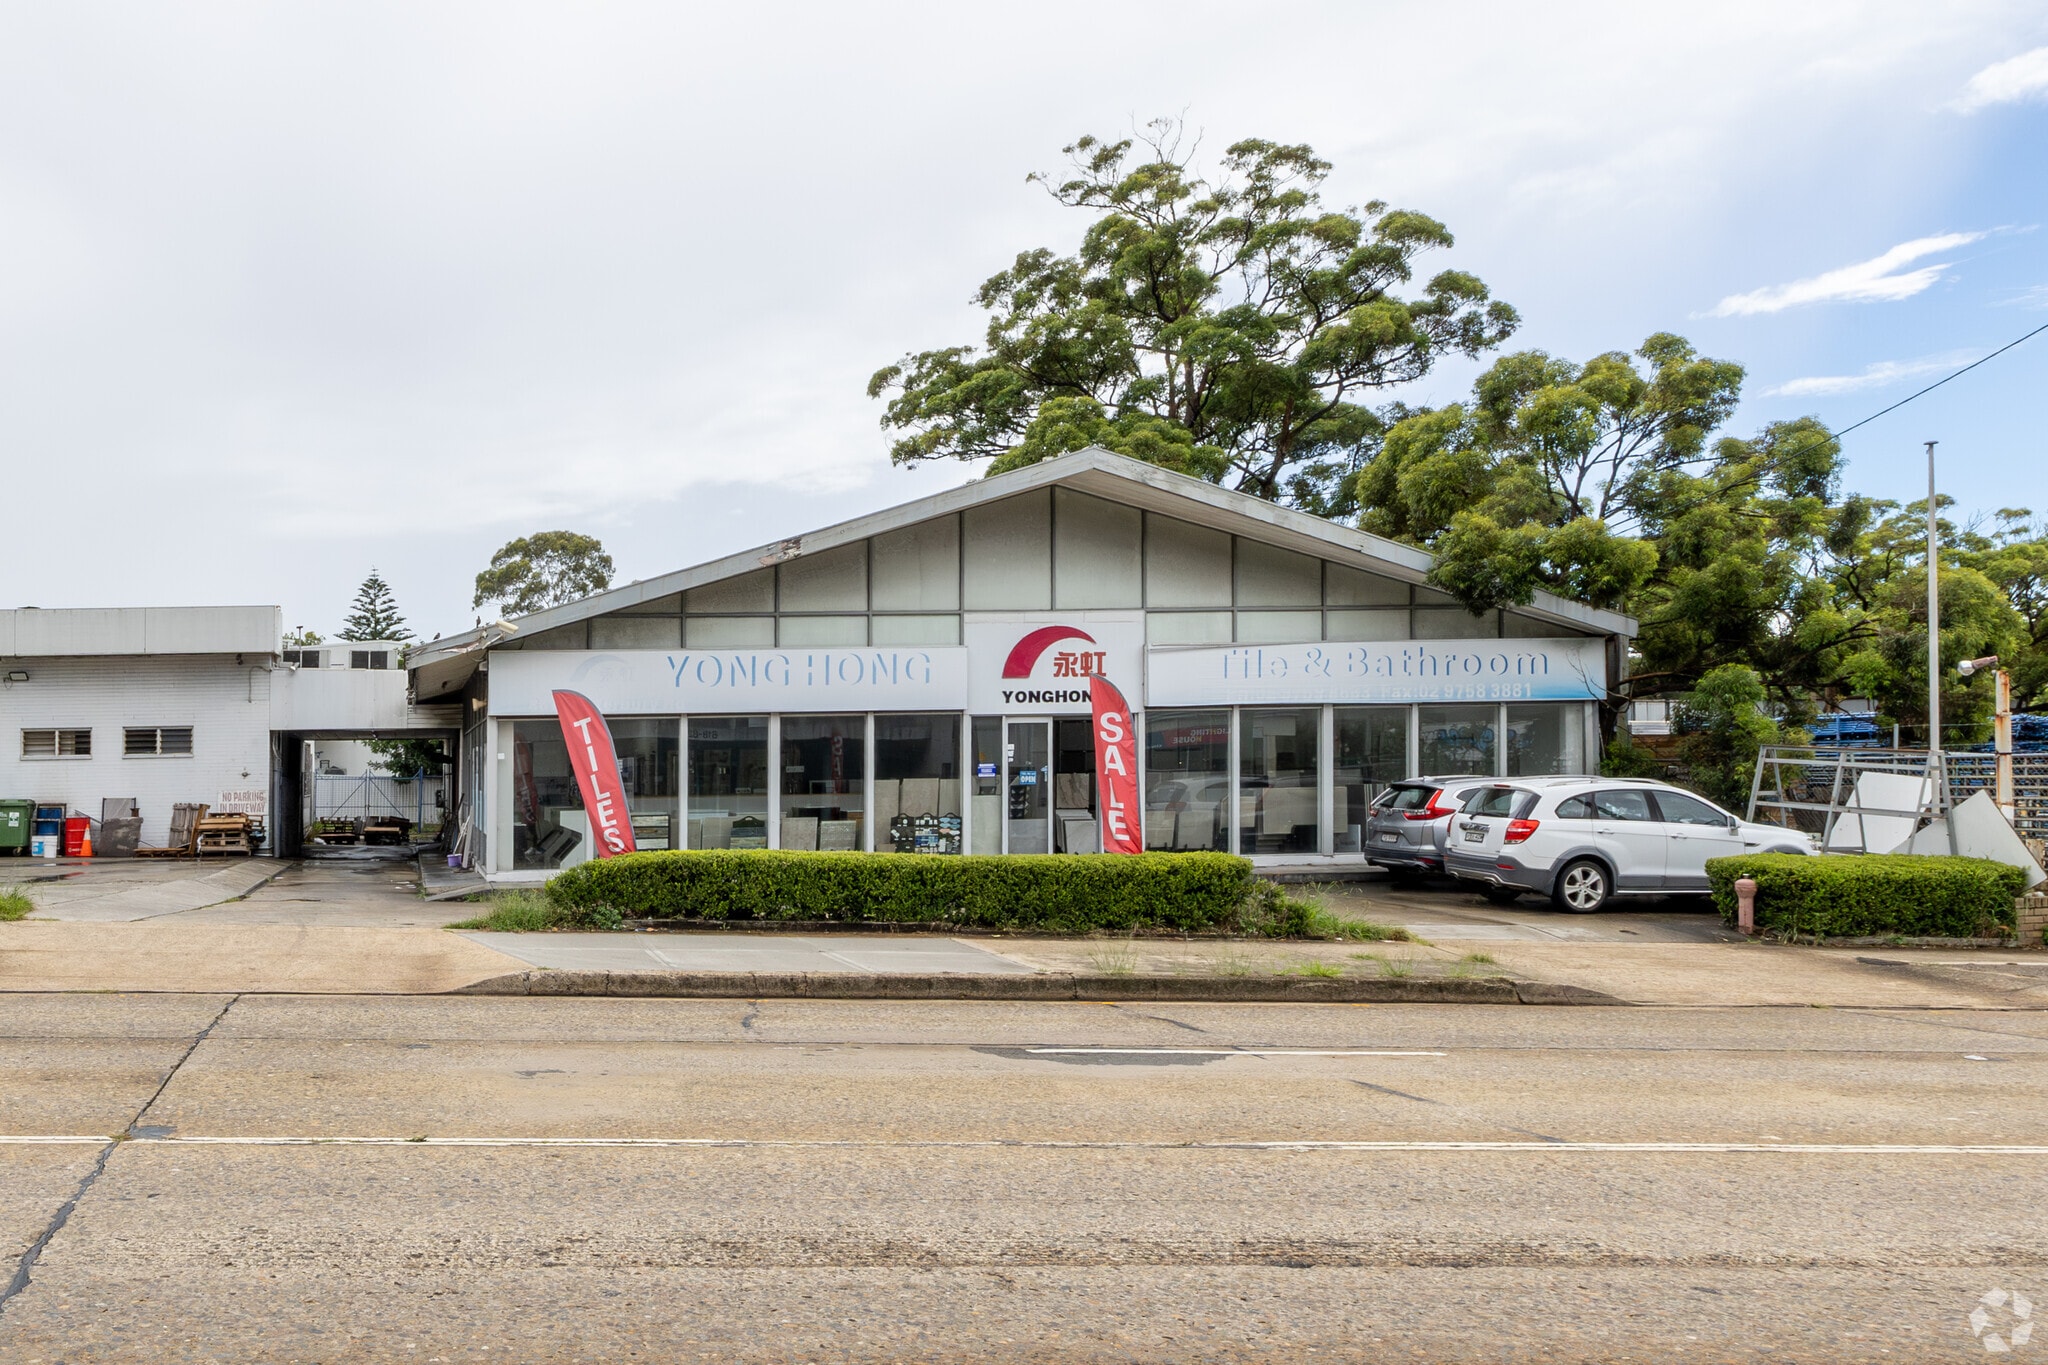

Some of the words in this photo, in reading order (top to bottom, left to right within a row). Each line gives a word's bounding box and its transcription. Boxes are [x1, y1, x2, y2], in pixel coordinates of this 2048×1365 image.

[1053, 651, 1107, 677] 永虹
[1304, 647, 1331, 678] &
[1348, 646, 1549, 677] Bathroom
[1002, 690, 1092, 703] YONGHON
[1443, 682, 1486, 698] 9758
[1490, 681, 1532, 698] 3881
[1020, 775, 1036, 783] OPEN
[1100, 711, 1130, 841] SALE
[573, 717, 625, 853] TILES
[222, 792, 232, 802] NO
[233, 791, 264, 802] PARKING
[220, 803, 227, 813] IN
[228, 802, 266, 813] DRIVEWAY
